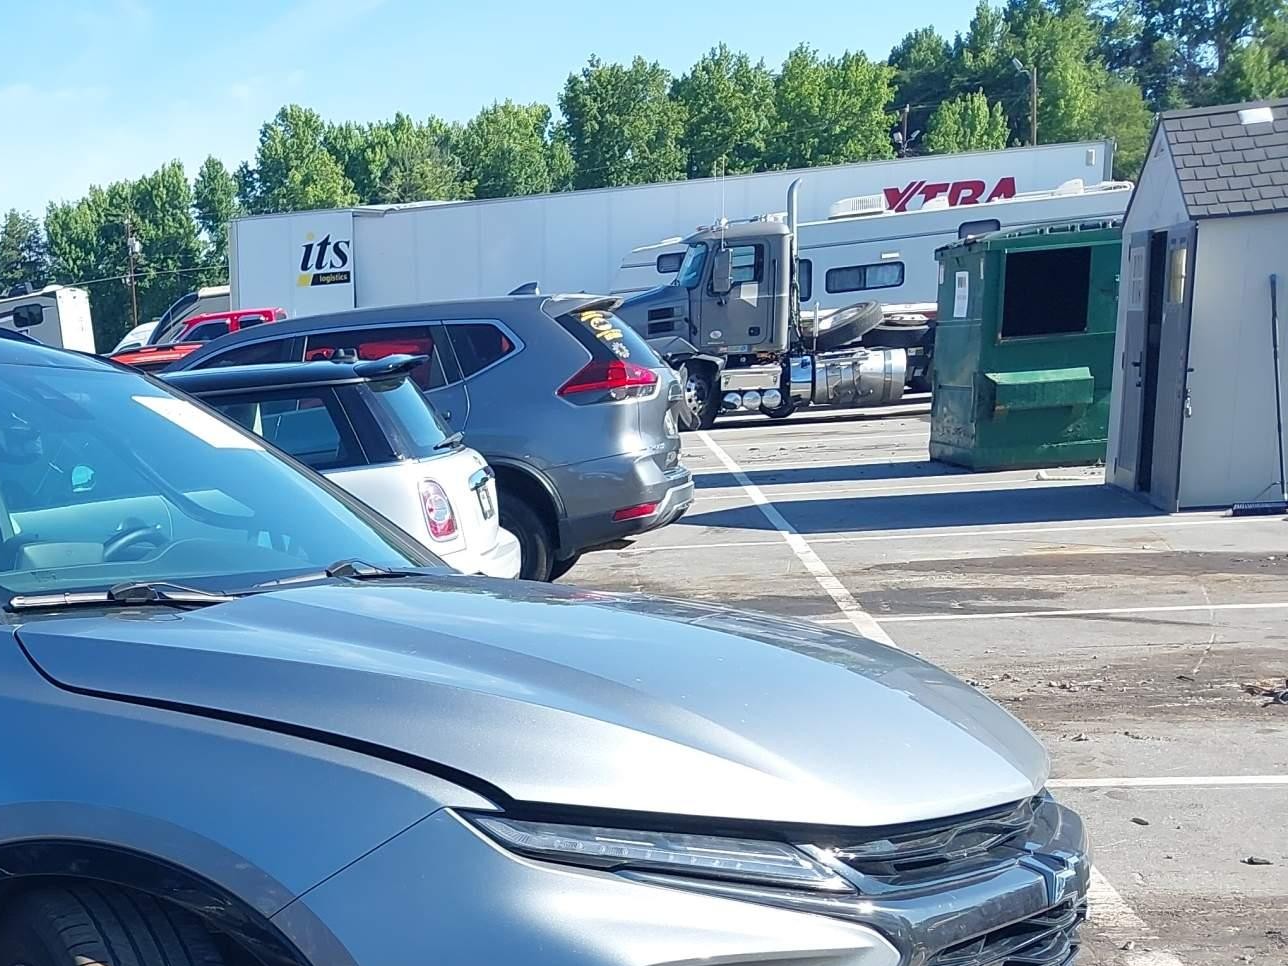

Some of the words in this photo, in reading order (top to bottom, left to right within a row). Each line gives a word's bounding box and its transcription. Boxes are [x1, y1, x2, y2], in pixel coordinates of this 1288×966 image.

[883, 176, 1017, 213] XTRA
[300, 232, 350, 271] its
[319, 273, 348, 283] logistics
